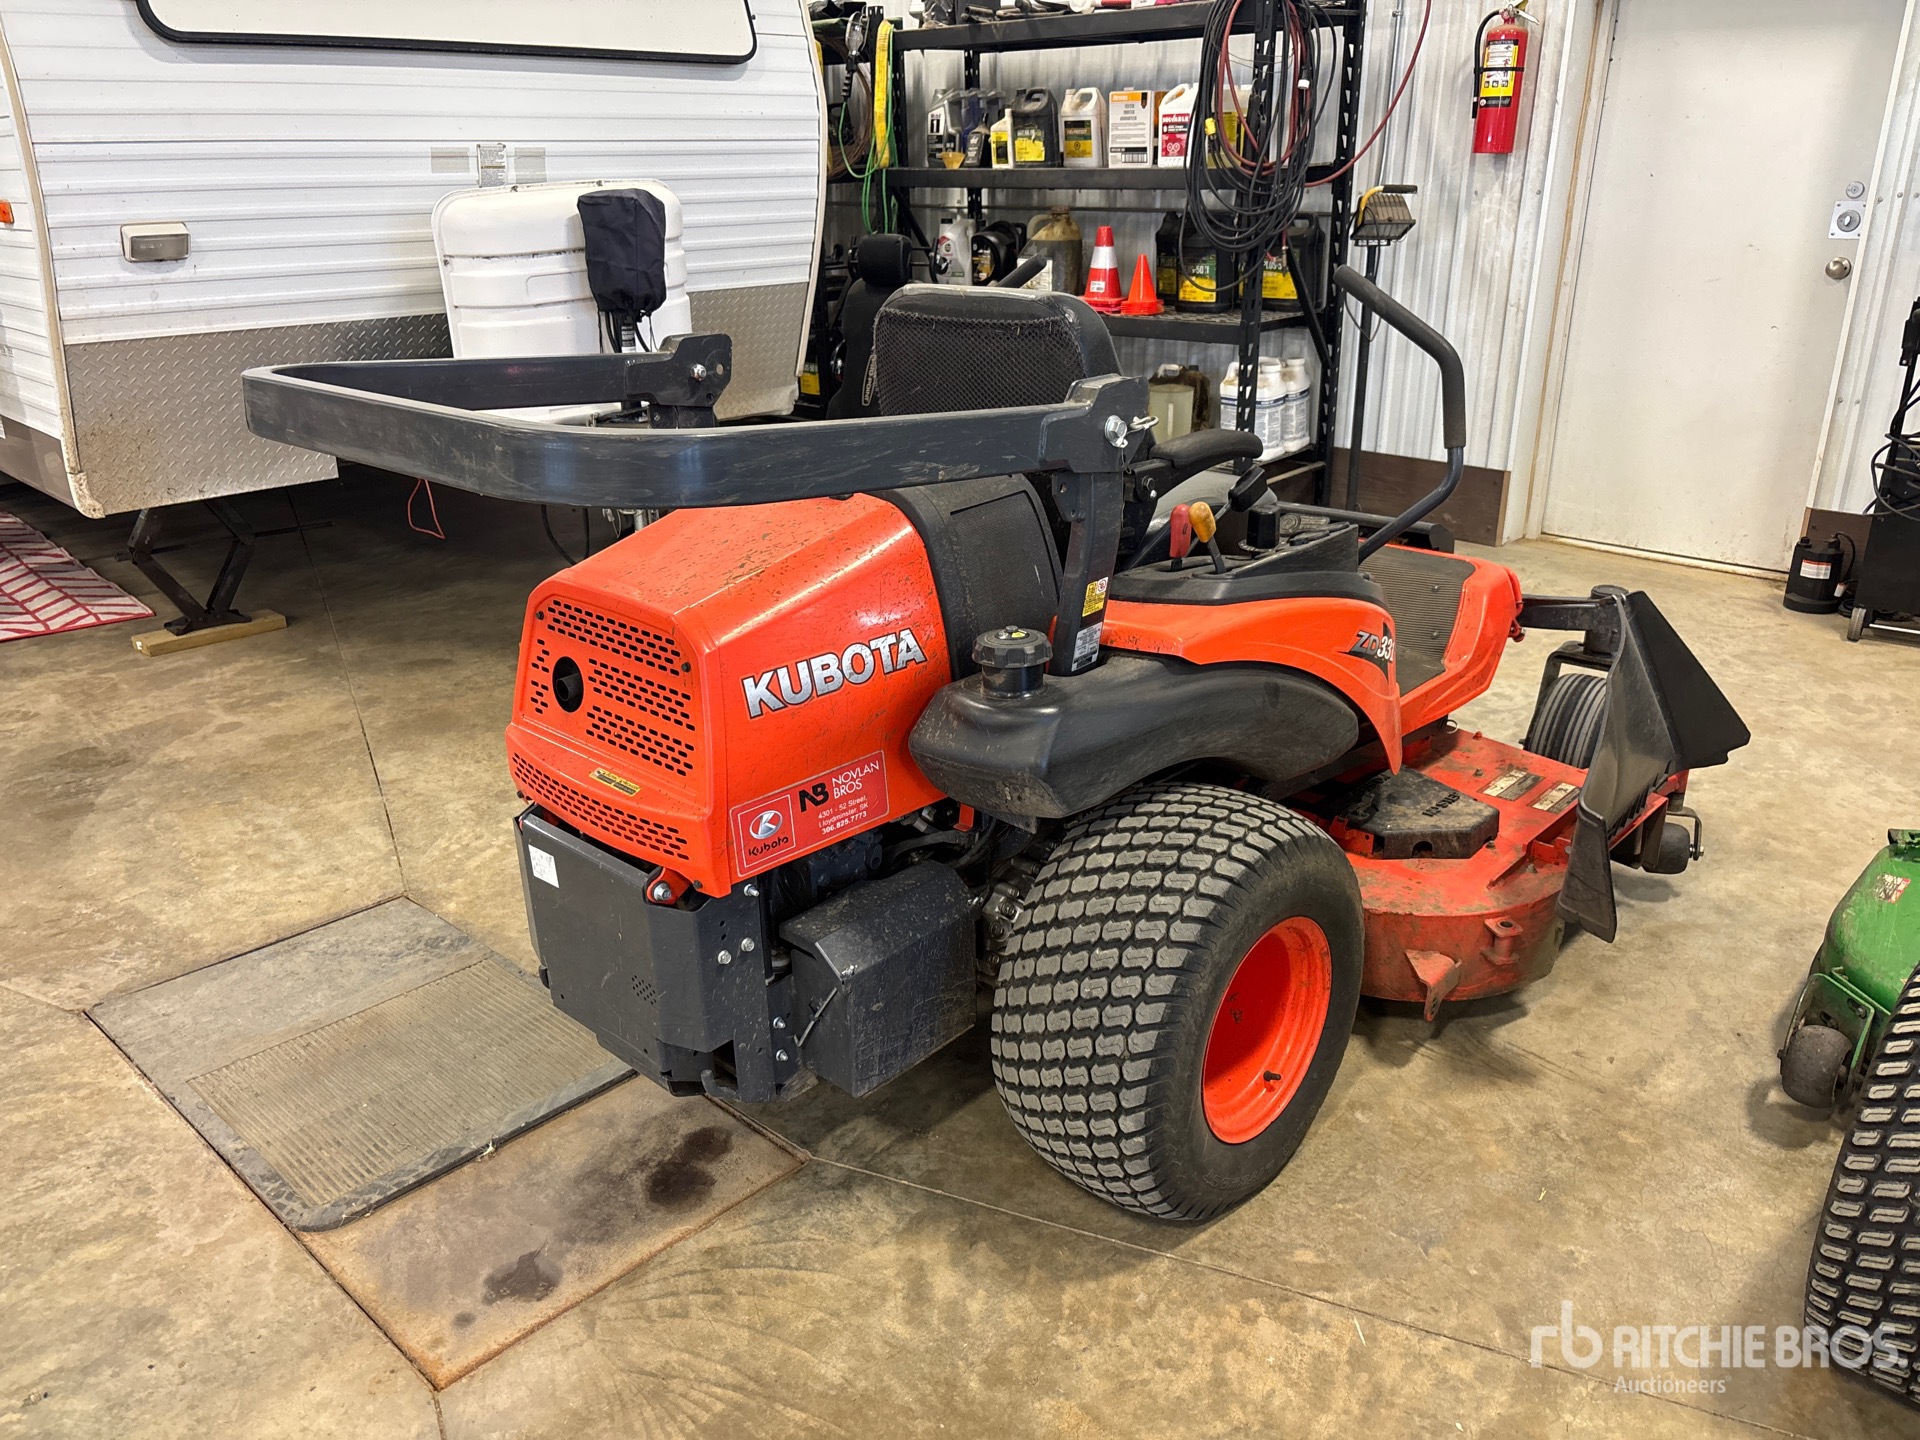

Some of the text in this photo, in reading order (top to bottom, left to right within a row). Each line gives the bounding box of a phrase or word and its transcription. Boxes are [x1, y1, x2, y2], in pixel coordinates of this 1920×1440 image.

[741, 628, 927, 719] KUBOTA
[831, 760, 880, 788] NOVLAN
[833, 778, 863, 799] BROS
[817, 808, 833, 820] 4301
[838, 802, 847, 811] 52
[859, 801, 869, 811] SK
[821, 811, 867, 835] 306.825.7773
[748, 836, 789, 857] Kubota
